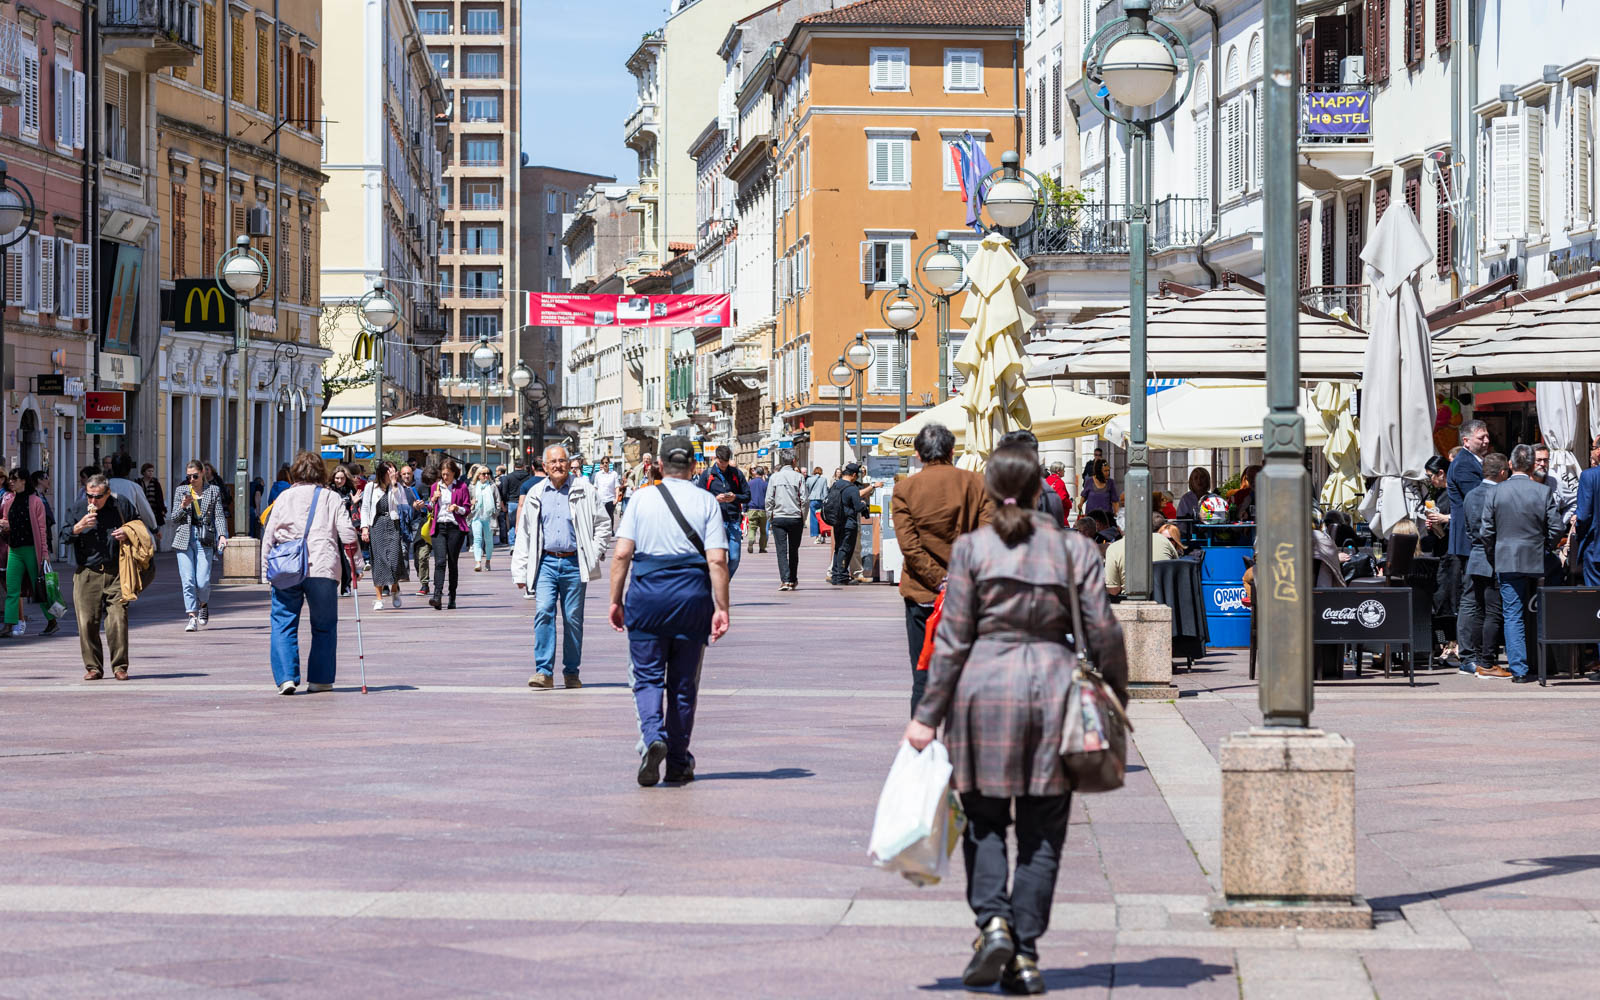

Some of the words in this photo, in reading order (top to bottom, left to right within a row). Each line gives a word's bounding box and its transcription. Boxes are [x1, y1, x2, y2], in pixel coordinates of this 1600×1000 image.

[1312, 95, 1366, 108] HAPPY
[1309, 113, 1369, 124] HOSTEL
[96, 404, 121, 412] Lutrija
